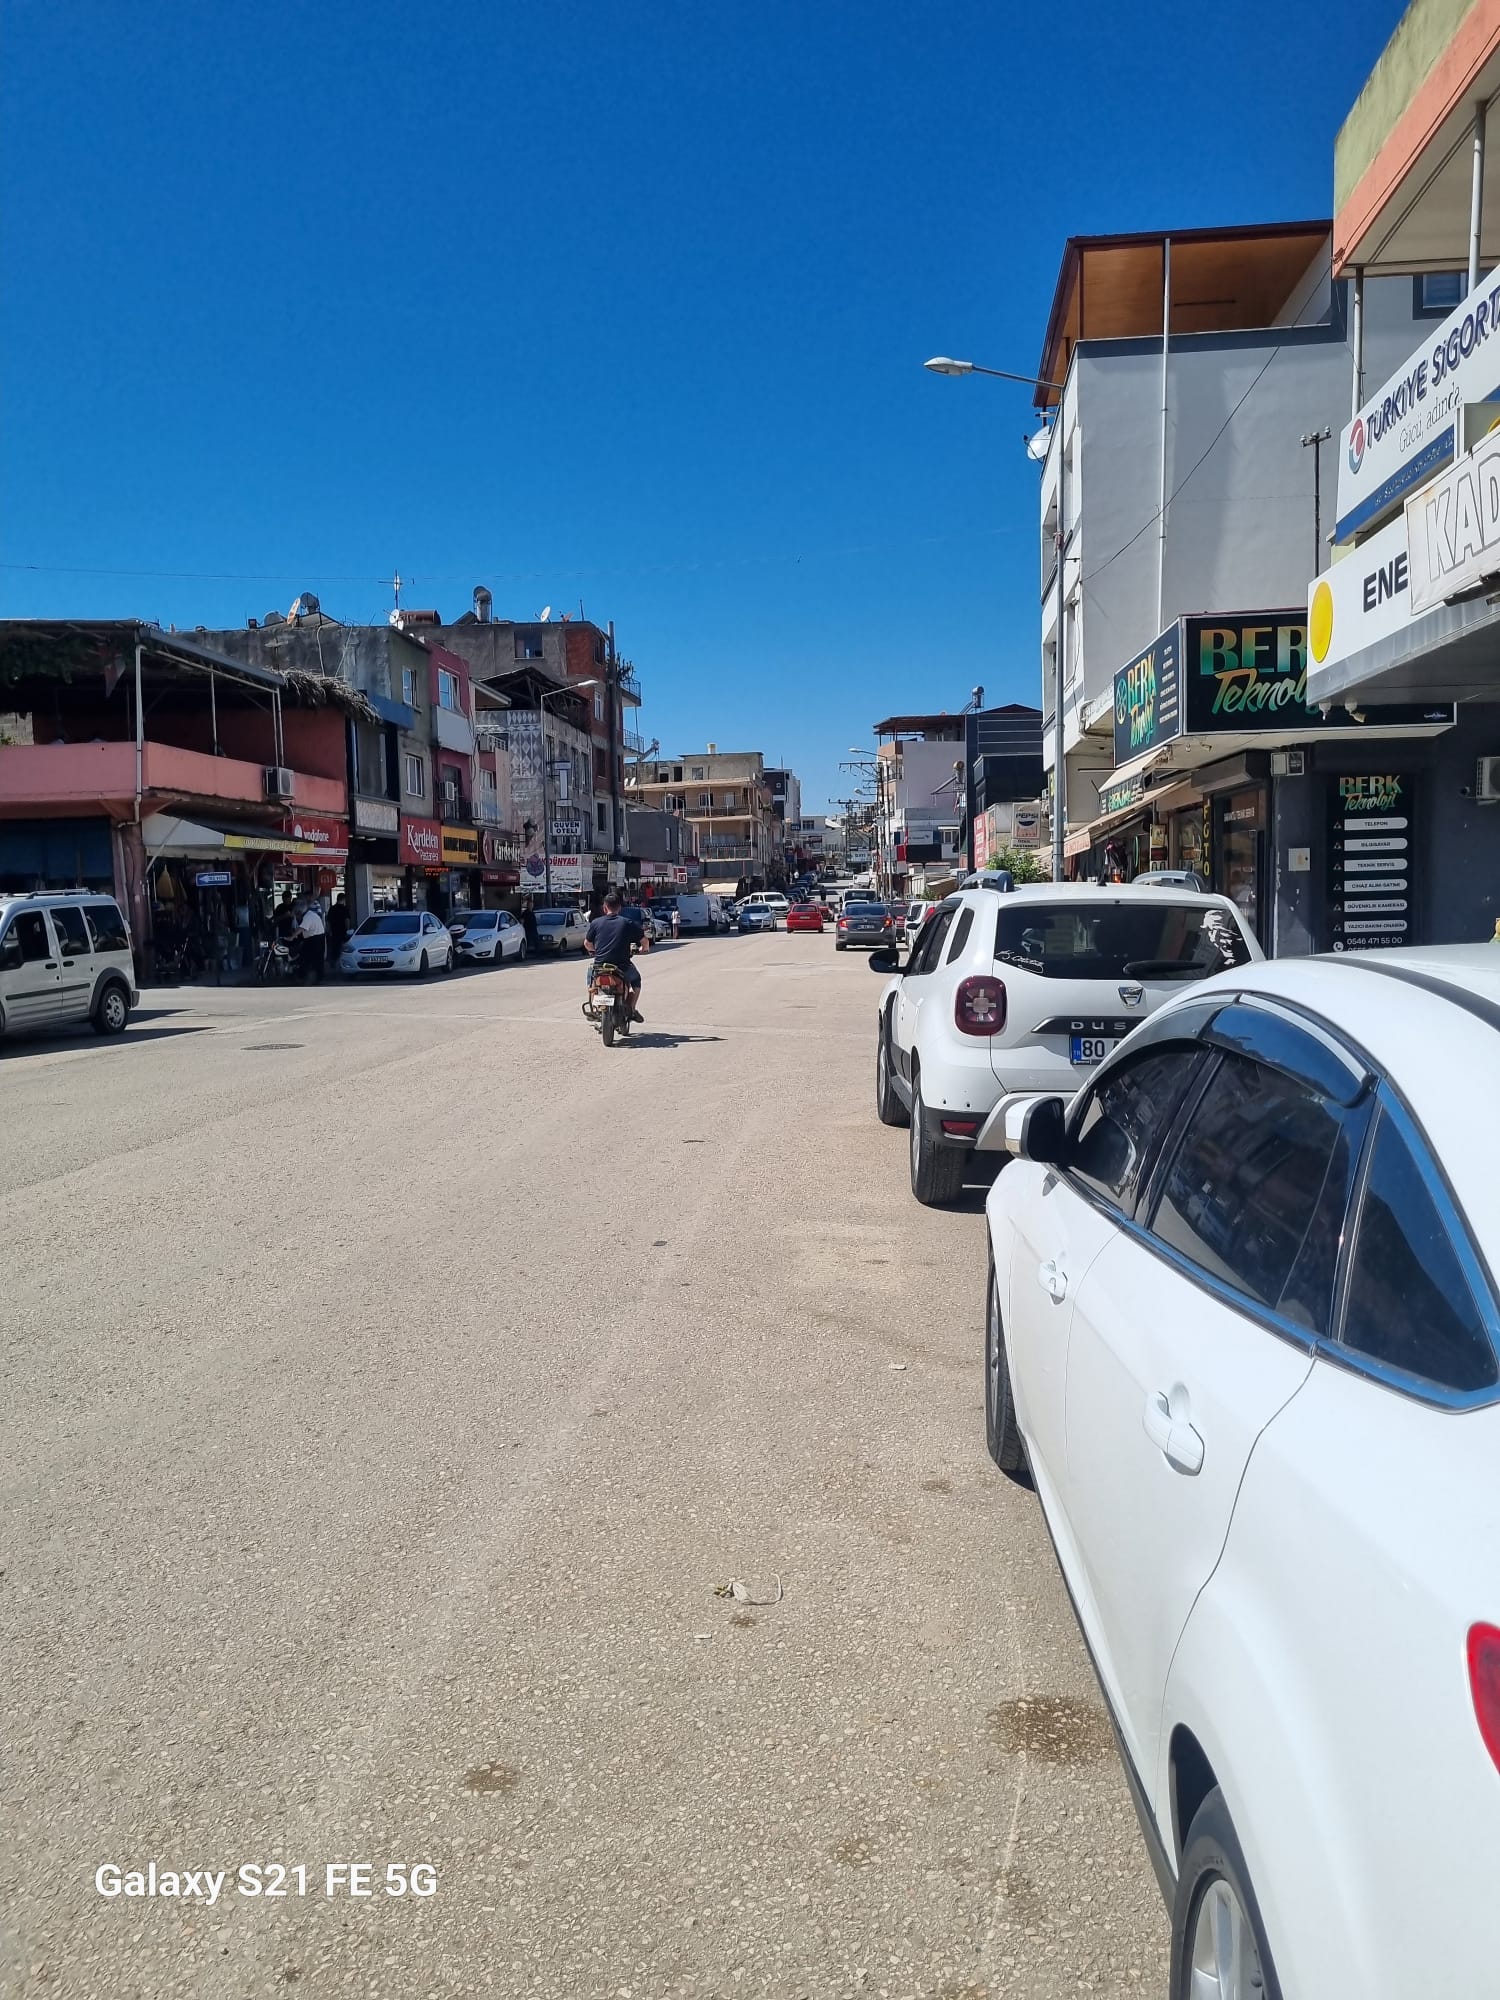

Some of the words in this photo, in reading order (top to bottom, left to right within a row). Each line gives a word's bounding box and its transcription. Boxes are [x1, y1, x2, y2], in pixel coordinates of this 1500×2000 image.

[1366, 360, 1428, 448] TÜRKİYE
[1432, 283, 1500, 387] SİGORT
[1127, 648, 1157, 714] BERK
[1340, 775, 1402, 796] BERK
[1344, 791, 1397, 811] Teknoloji
[303, 828, 329, 842] vodafone
[407, 824, 439, 853] Kardelen
[1346, 937, 1366, 945] 0546
[1368, 937, 1380, 945] 471
[1391, 936, 1403, 944] 00
[1082, 1040, 1105, 1058] 80
